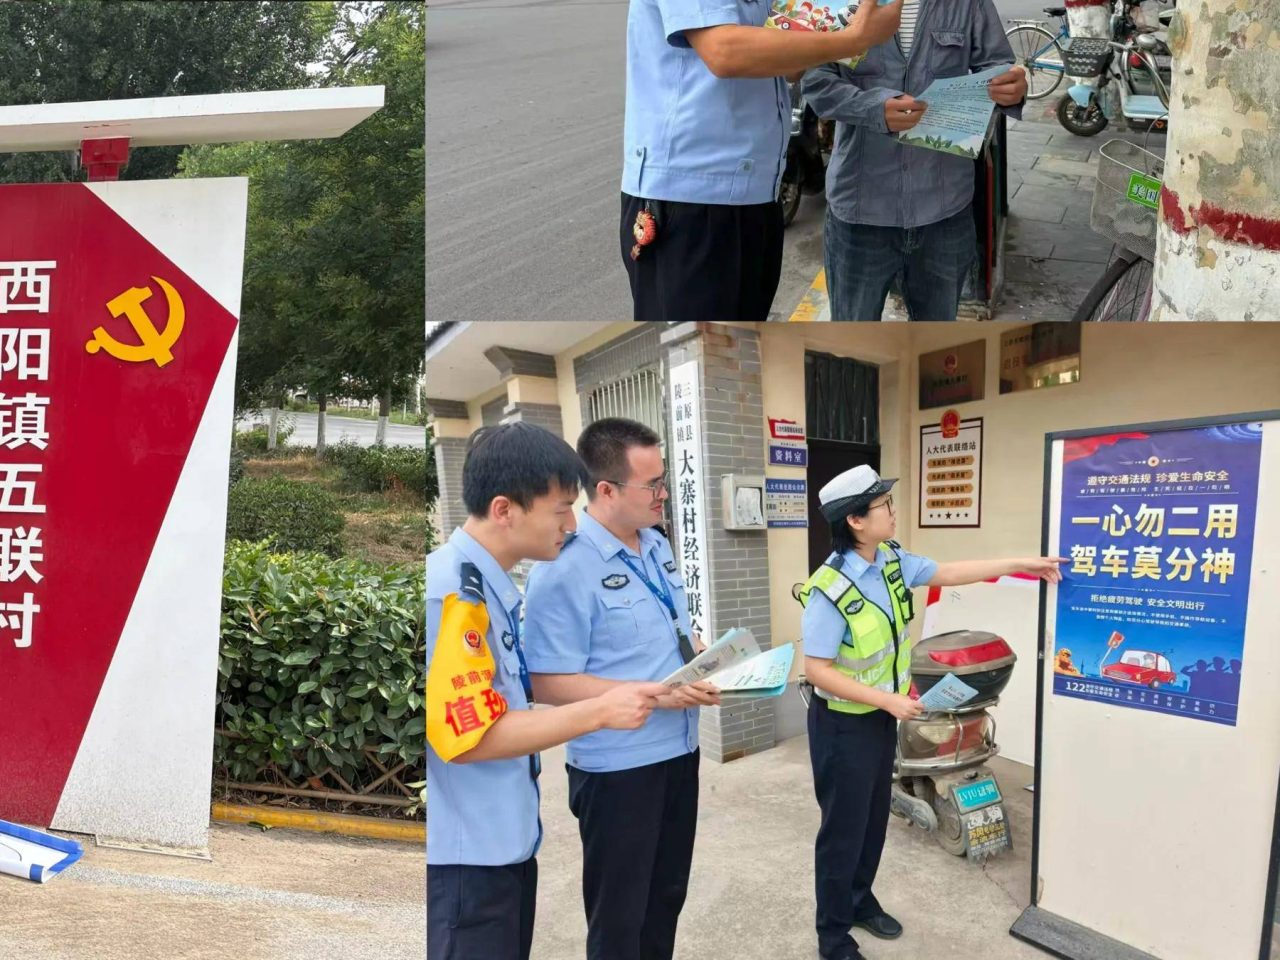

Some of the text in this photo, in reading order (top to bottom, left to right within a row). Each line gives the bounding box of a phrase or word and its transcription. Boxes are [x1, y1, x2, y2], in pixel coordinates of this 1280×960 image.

[775, 449, 802, 463] 资料室
[1087, 470, 1230, 486] 遵守交通法规 珍爱生命安全
[1071, 502, 1239, 539] 一心勿二用
[1070, 543, 1237, 585] 驾车莫分神
[1090, 593, 1205, 611] 拒绝疲劳驾驶 安全文明出行
[1065, 681, 1086, 694] 122
